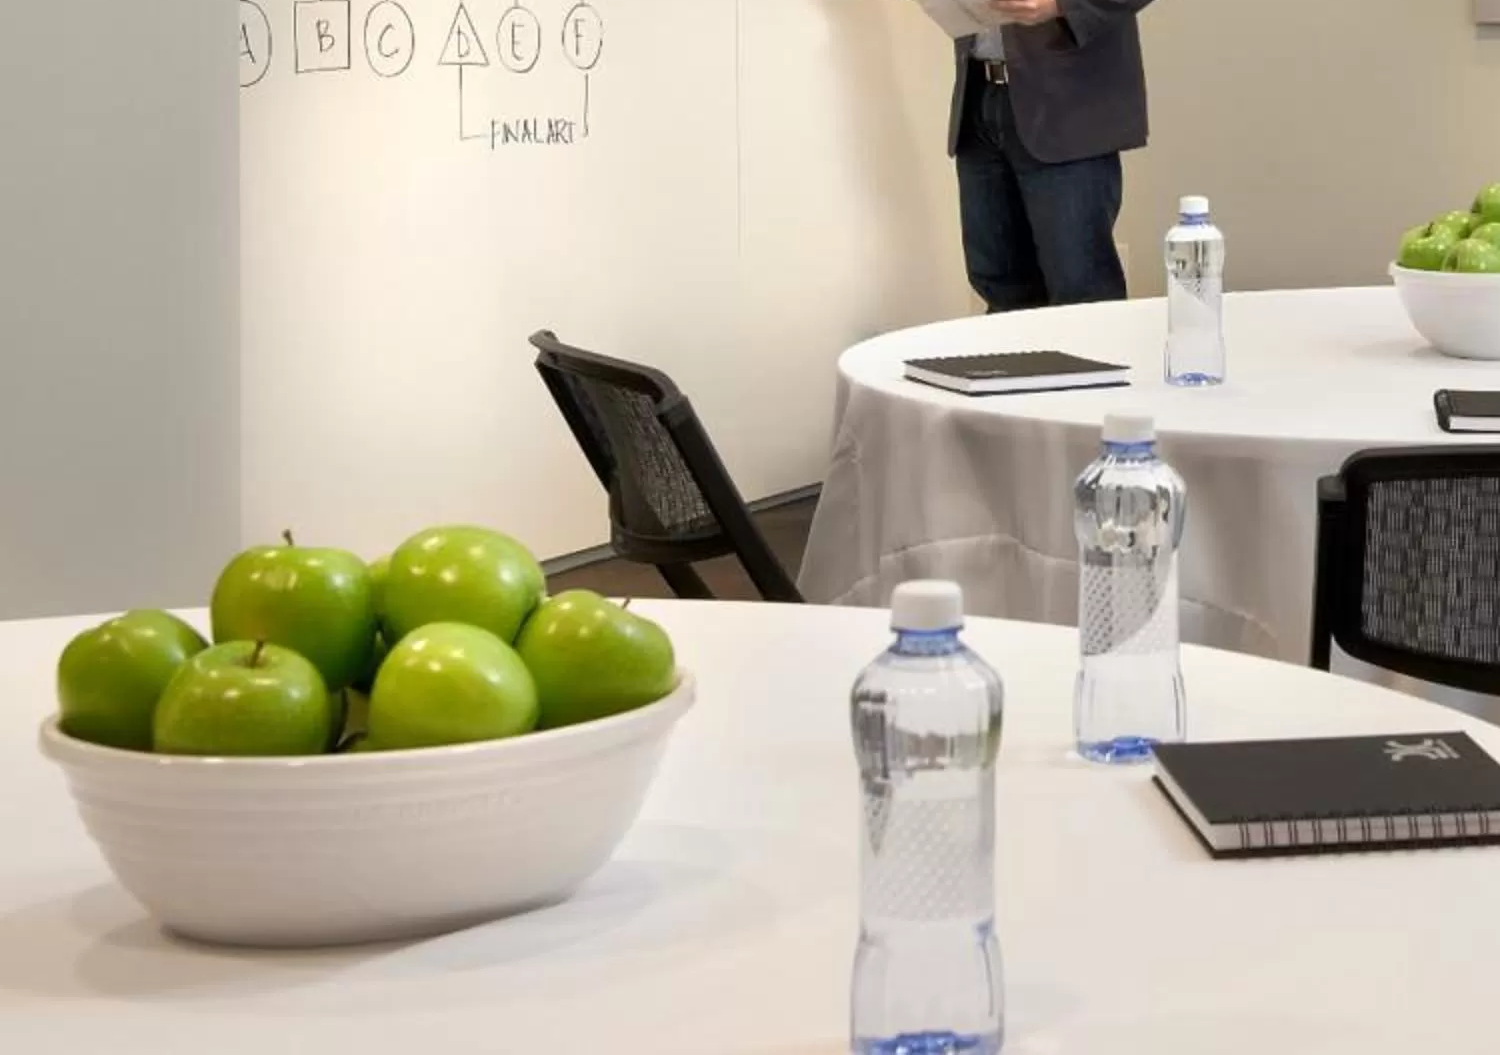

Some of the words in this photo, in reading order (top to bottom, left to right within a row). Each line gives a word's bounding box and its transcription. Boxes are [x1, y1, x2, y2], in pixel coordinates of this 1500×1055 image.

[315, 18, 335, 54] B
[377, 25, 400, 58] C
[456, 33, 471, 58] D
[511, 23, 526, 62] E
[573, 17, 586, 56] F
[546, 118, 576, 145] ART
